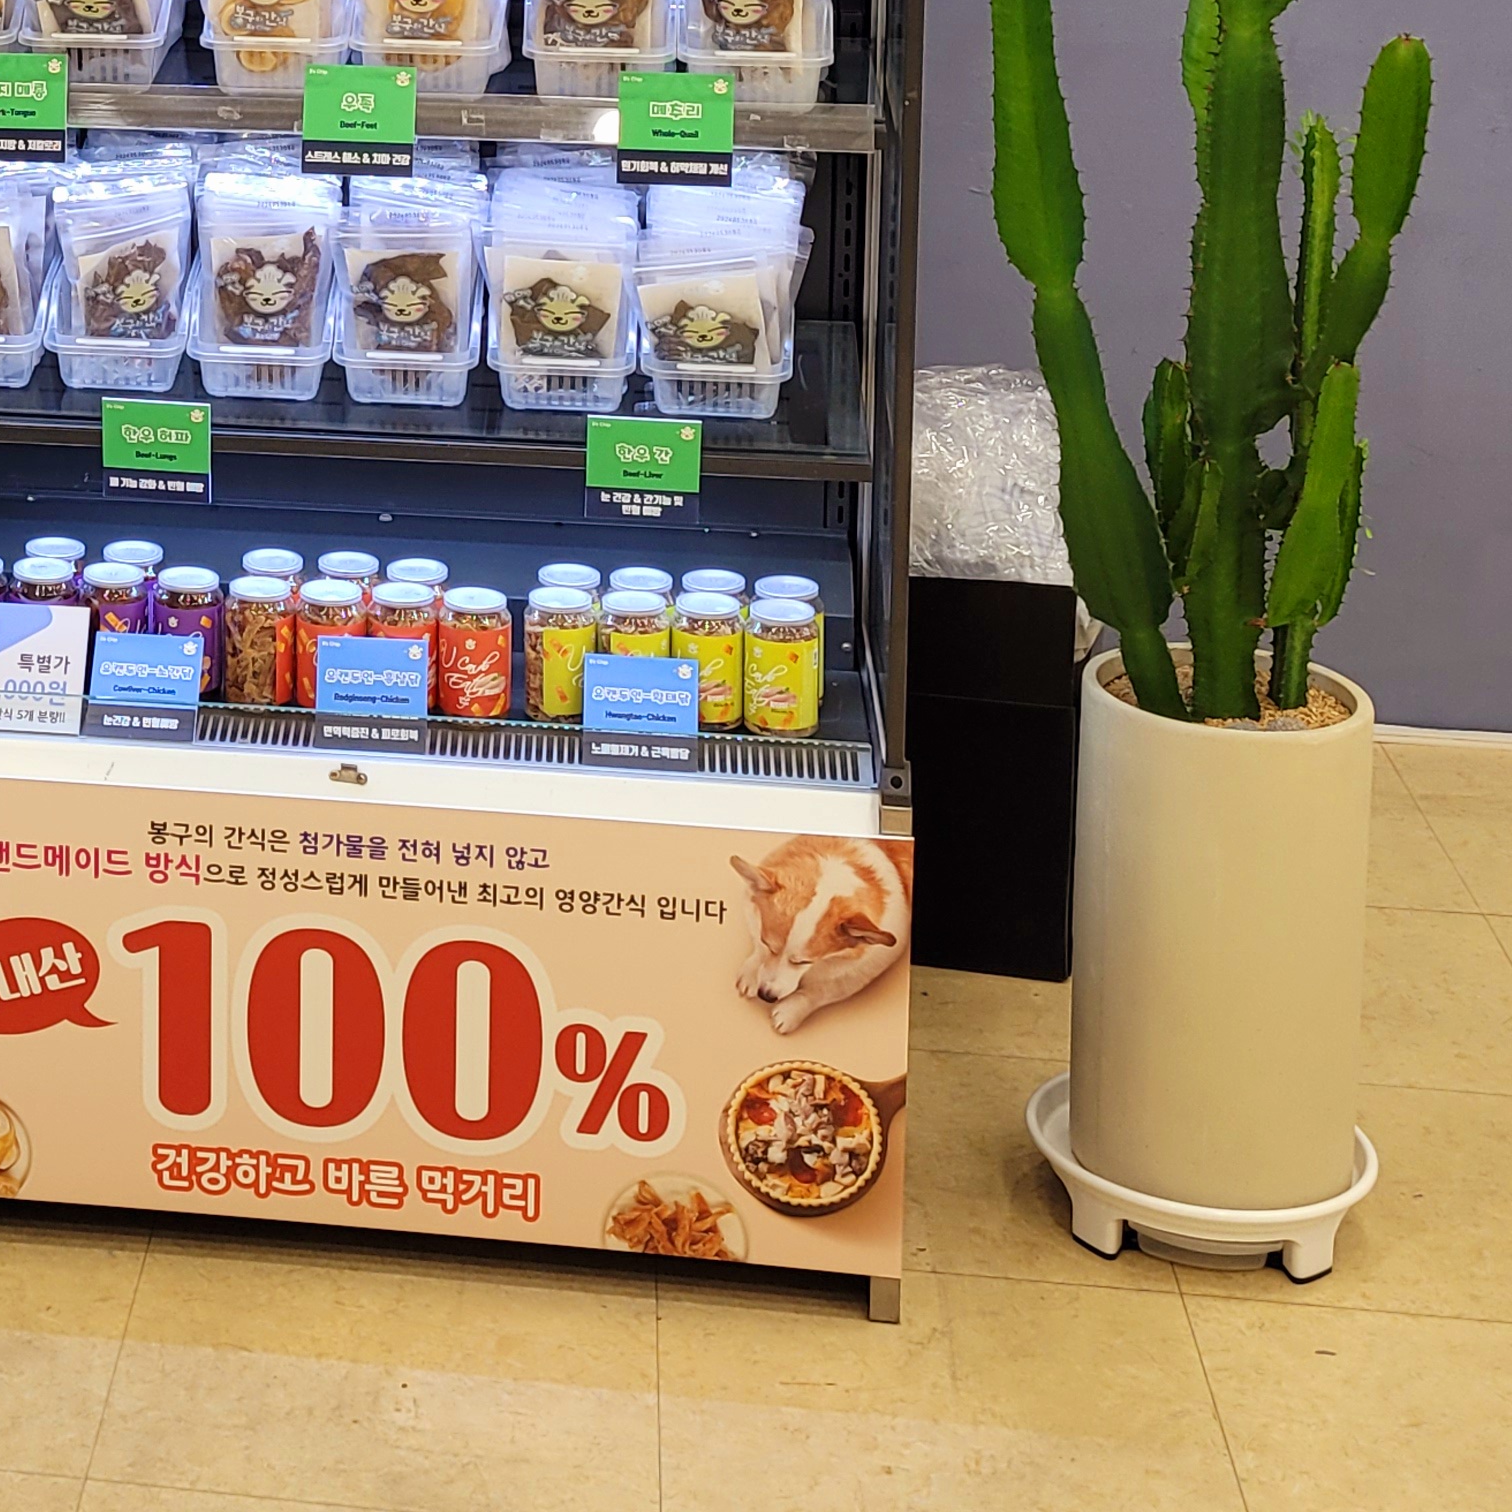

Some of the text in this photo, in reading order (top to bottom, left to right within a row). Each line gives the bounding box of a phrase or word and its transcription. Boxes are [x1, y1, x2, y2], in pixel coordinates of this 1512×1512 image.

[650, 100, 702, 120] 메추리
[121, 424, 191, 444] 한우 허파
[615, 443, 673, 464] 한우 간
[18, 654, 70, 674] 특별가
[16, 709, 34, 722] 5개
[148, 820, 550, 870] 봉구의 간식은 첨가물을 전혀 넣지 않고
[144, 851, 248, 886] 방식으로
[257, 865, 368, 898] 정성스럽게
[378, 875, 468, 904] 만들어낸
[477, 881, 544, 911] 최고의
[554, 888, 646, 918] 영양간식
[657, 895, 727, 924] 입니다
[121, 920, 669, 1142] 100%
[151, 1144, 541, 1223] 건강하고 바른 먹거리
